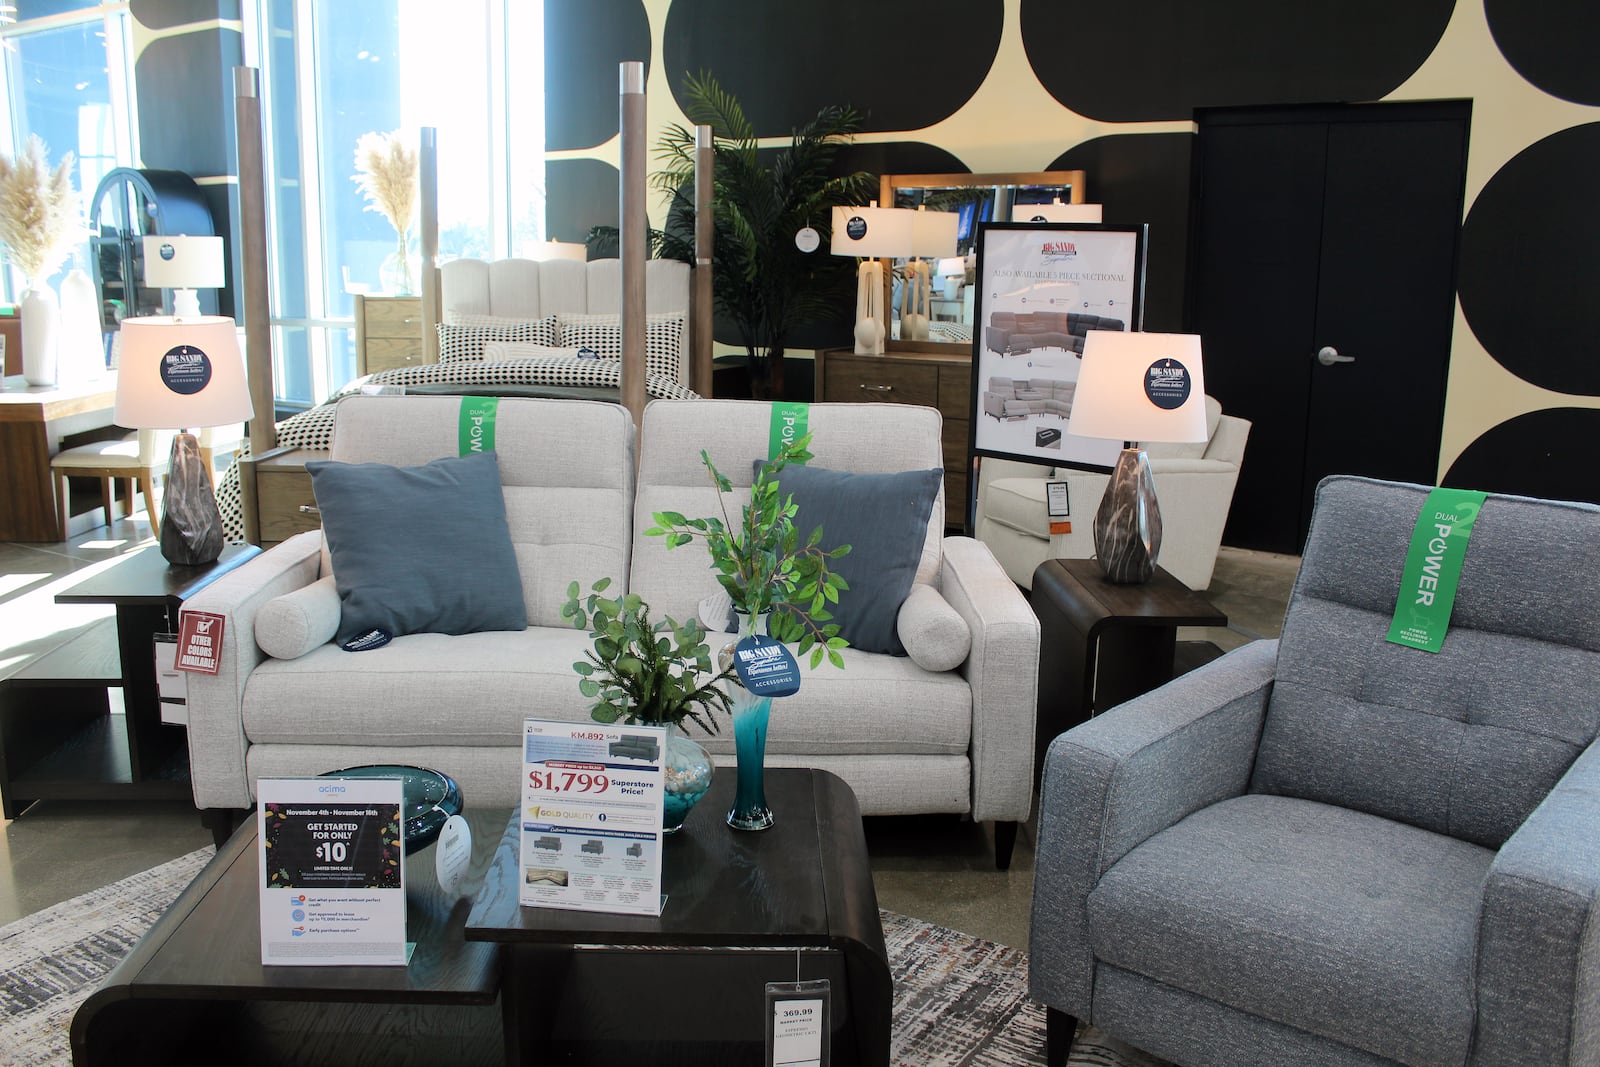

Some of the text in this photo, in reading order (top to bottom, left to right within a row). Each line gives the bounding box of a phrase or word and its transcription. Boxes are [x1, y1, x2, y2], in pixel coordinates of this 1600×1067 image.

[1014, 270, 1050, 279] AVAILABLE
[1059, 272, 1080, 280] PIECE
[1082, 272, 1126, 282] SECTIONAL
[166, 354, 203, 364] BIG SANDY
[1150, 367, 1184, 378] BIG SANDY
[470, 416, 483, 452] POW
[1434, 512, 1459, 523] DUAL
[1415, 523, 1451, 607] POWER
[1400, 630, 1428, 640] RECLINING
[1409, 628, 1427, 636] POWER
[191, 634, 212, 645] OTHER
[188, 645, 213, 657] COLORS
[738, 645, 782, 662] BIG SANDY
[182, 655, 216, 668] AVAILABLE
[755, 677, 792, 688] ACCESSORIES
[571, 732, 604, 740] KM.892
[529, 770, 609, 794] $1,799
[611, 780, 654, 788] Superstore
[562, 811, 594, 820] QUALITY
[784, 1008, 813, 1017] 369.99
